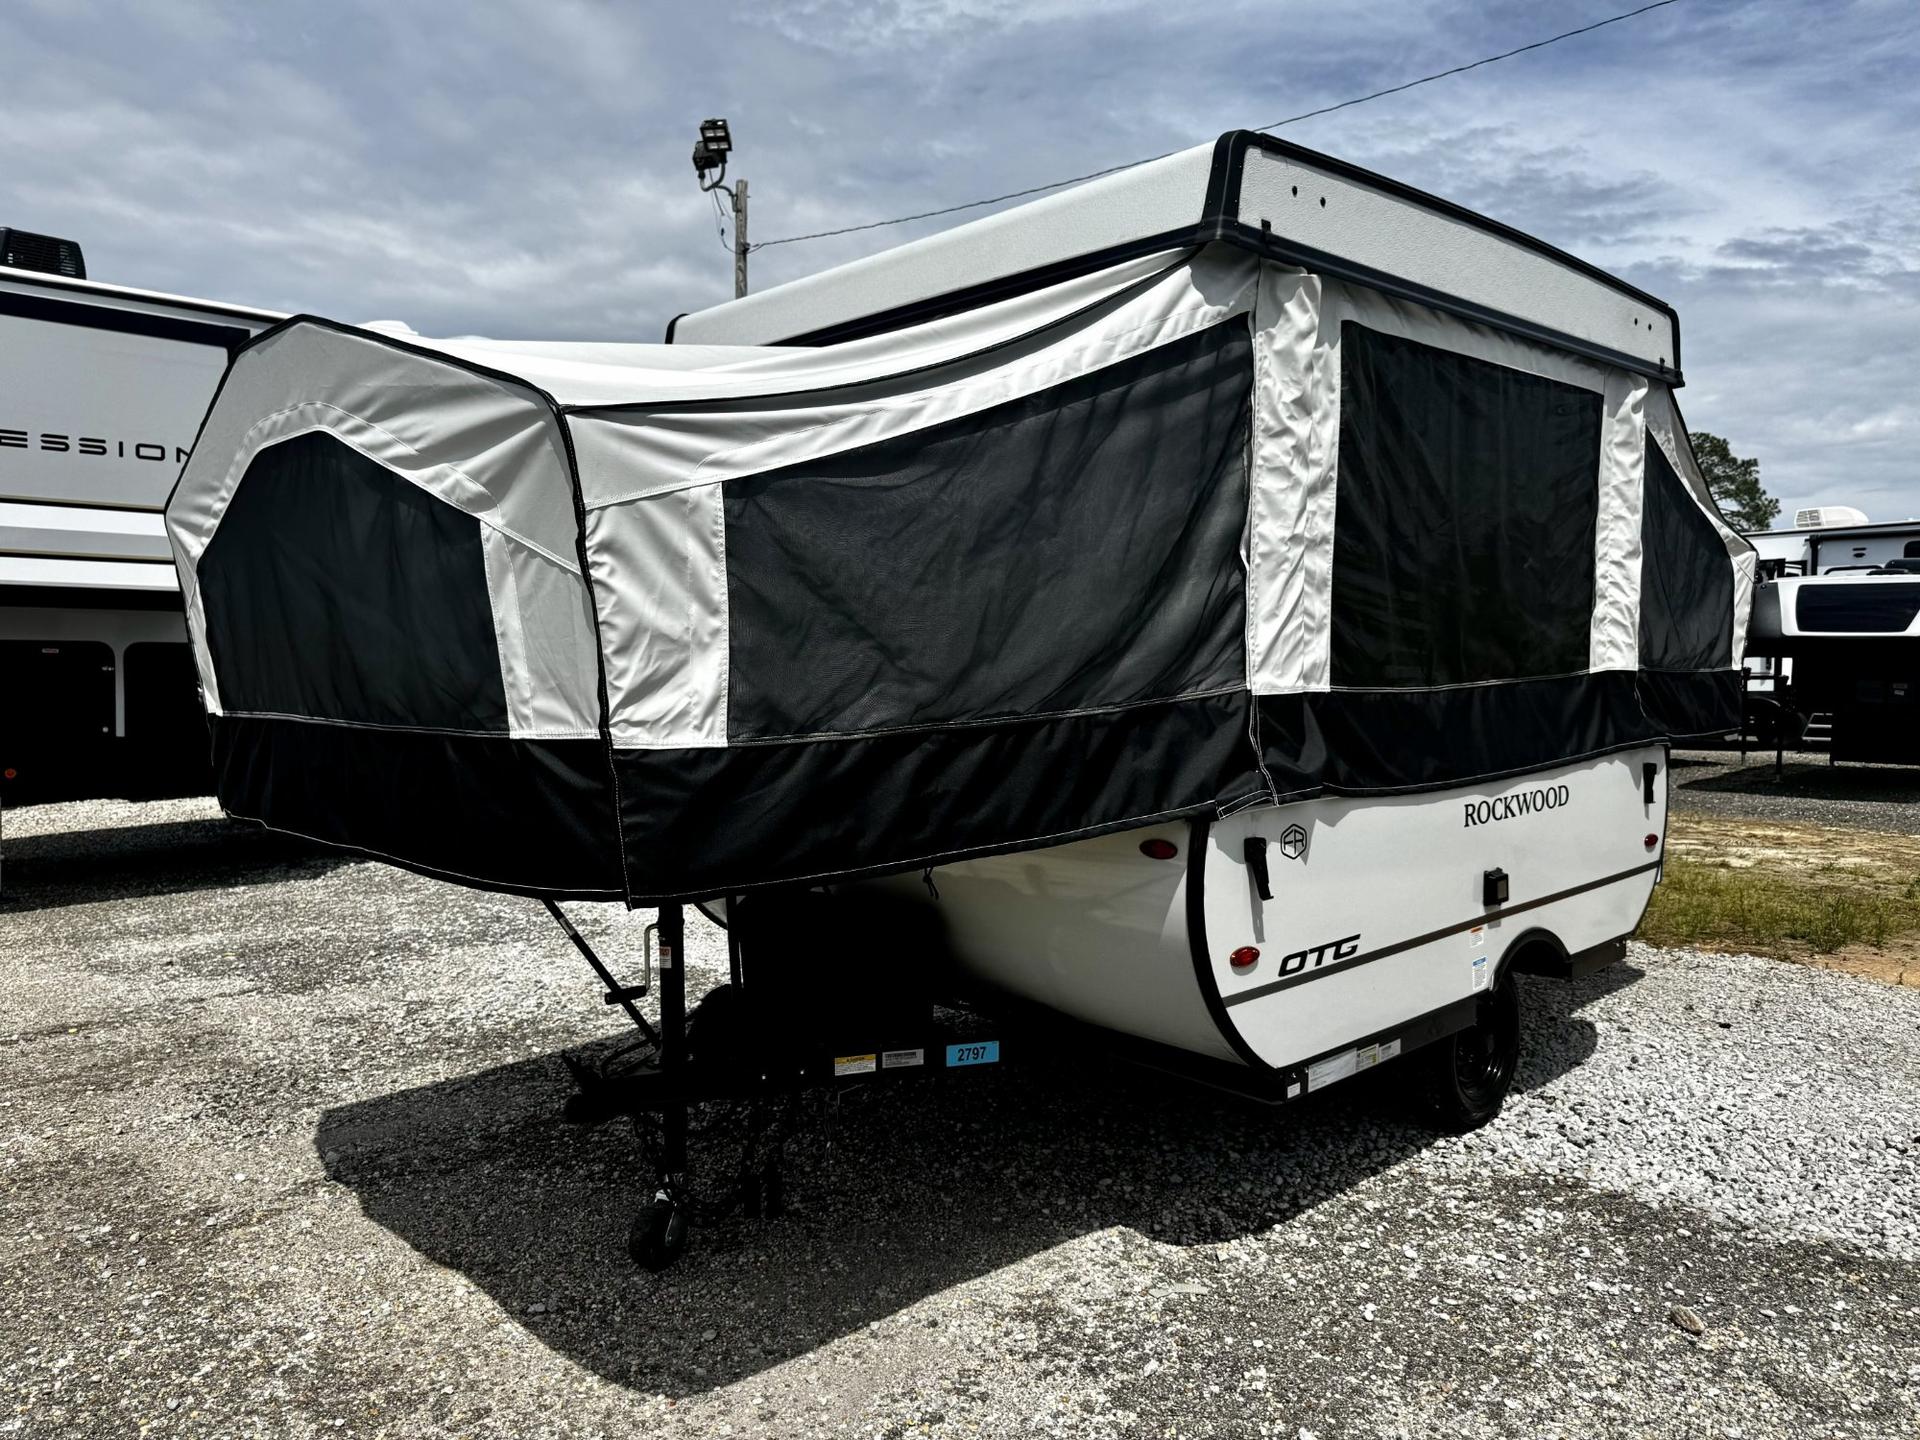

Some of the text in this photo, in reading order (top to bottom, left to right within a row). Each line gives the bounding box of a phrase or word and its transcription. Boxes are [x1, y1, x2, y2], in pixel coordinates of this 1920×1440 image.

[1464, 785, 1569, 828] ROCKWOOD
[1278, 933, 1361, 977] OTG
[957, 1046, 987, 1062] 2797
